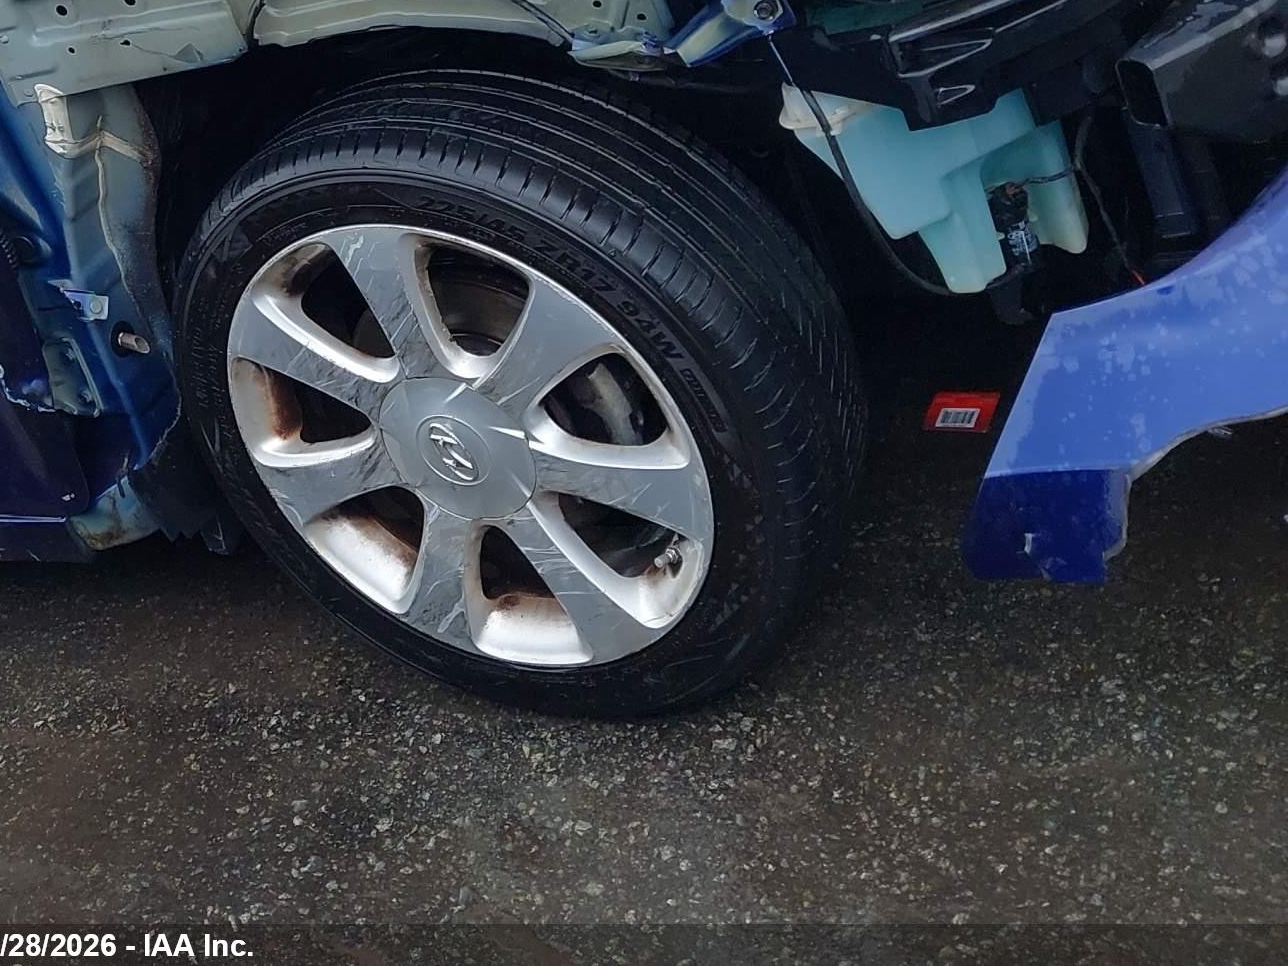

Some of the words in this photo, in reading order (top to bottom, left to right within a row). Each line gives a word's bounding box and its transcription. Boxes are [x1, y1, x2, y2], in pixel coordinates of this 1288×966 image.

[416, 196, 526, 242] 225/45
[530, 240, 617, 294] ZR17
[616, 299, 684, 363] 94W
